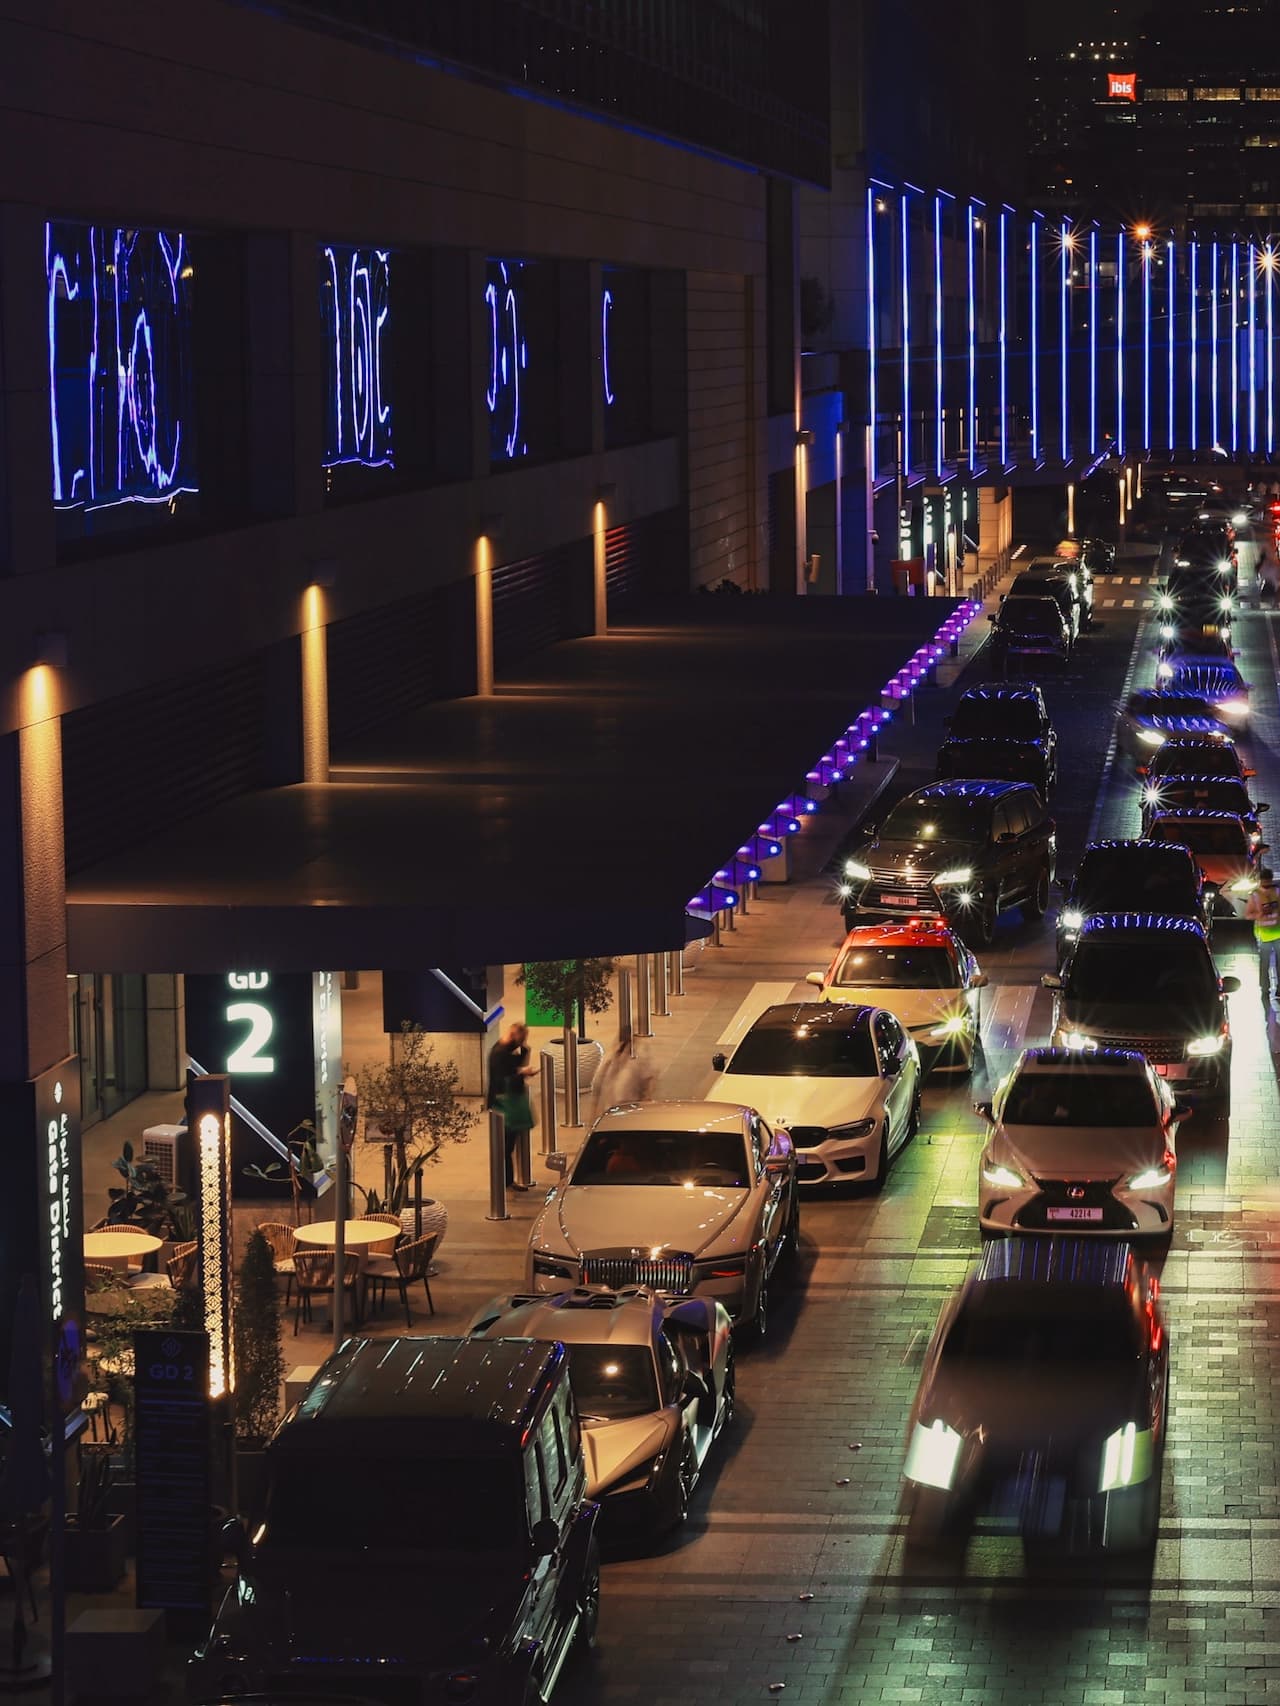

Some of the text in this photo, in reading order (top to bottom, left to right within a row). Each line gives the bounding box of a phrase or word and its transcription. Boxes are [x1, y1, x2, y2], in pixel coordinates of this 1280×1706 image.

[1111, 81, 1132, 94] ibis
[226, 1003, 274, 1073] 2
[48, 1119, 63, 1320] Gate District
[149, 1364, 179, 1380] GD
